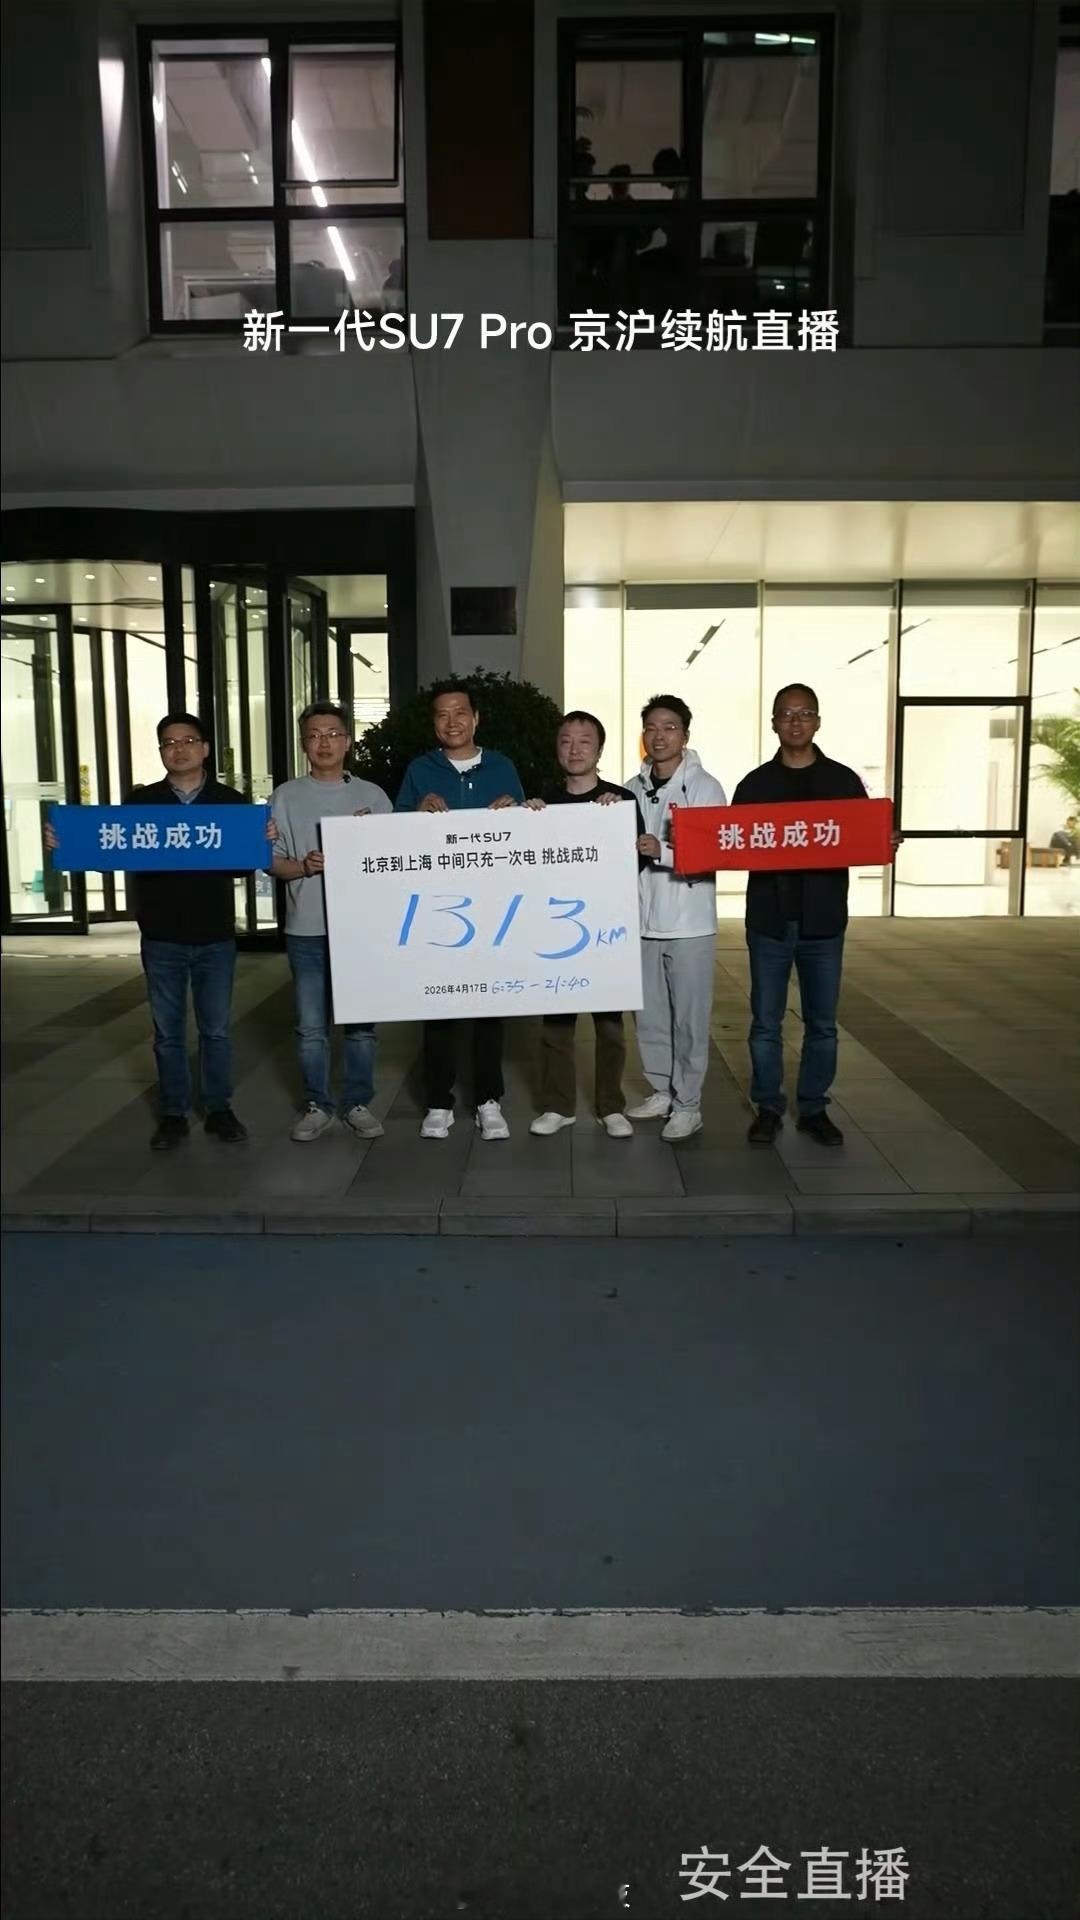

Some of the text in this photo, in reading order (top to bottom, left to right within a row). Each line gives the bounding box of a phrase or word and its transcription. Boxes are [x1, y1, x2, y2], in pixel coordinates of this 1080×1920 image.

[99, 822, 222, 850] 挑战成功
[446, 832, 512, 844] 新一代SU7
[718, 819, 841, 850] 挑战成功
[362, 845, 599, 873] 北京到上海 中间只充一次电 挑战成功
[397, 894, 591, 960] 1313
[424, 983, 488, 995] 2026年4月17日
